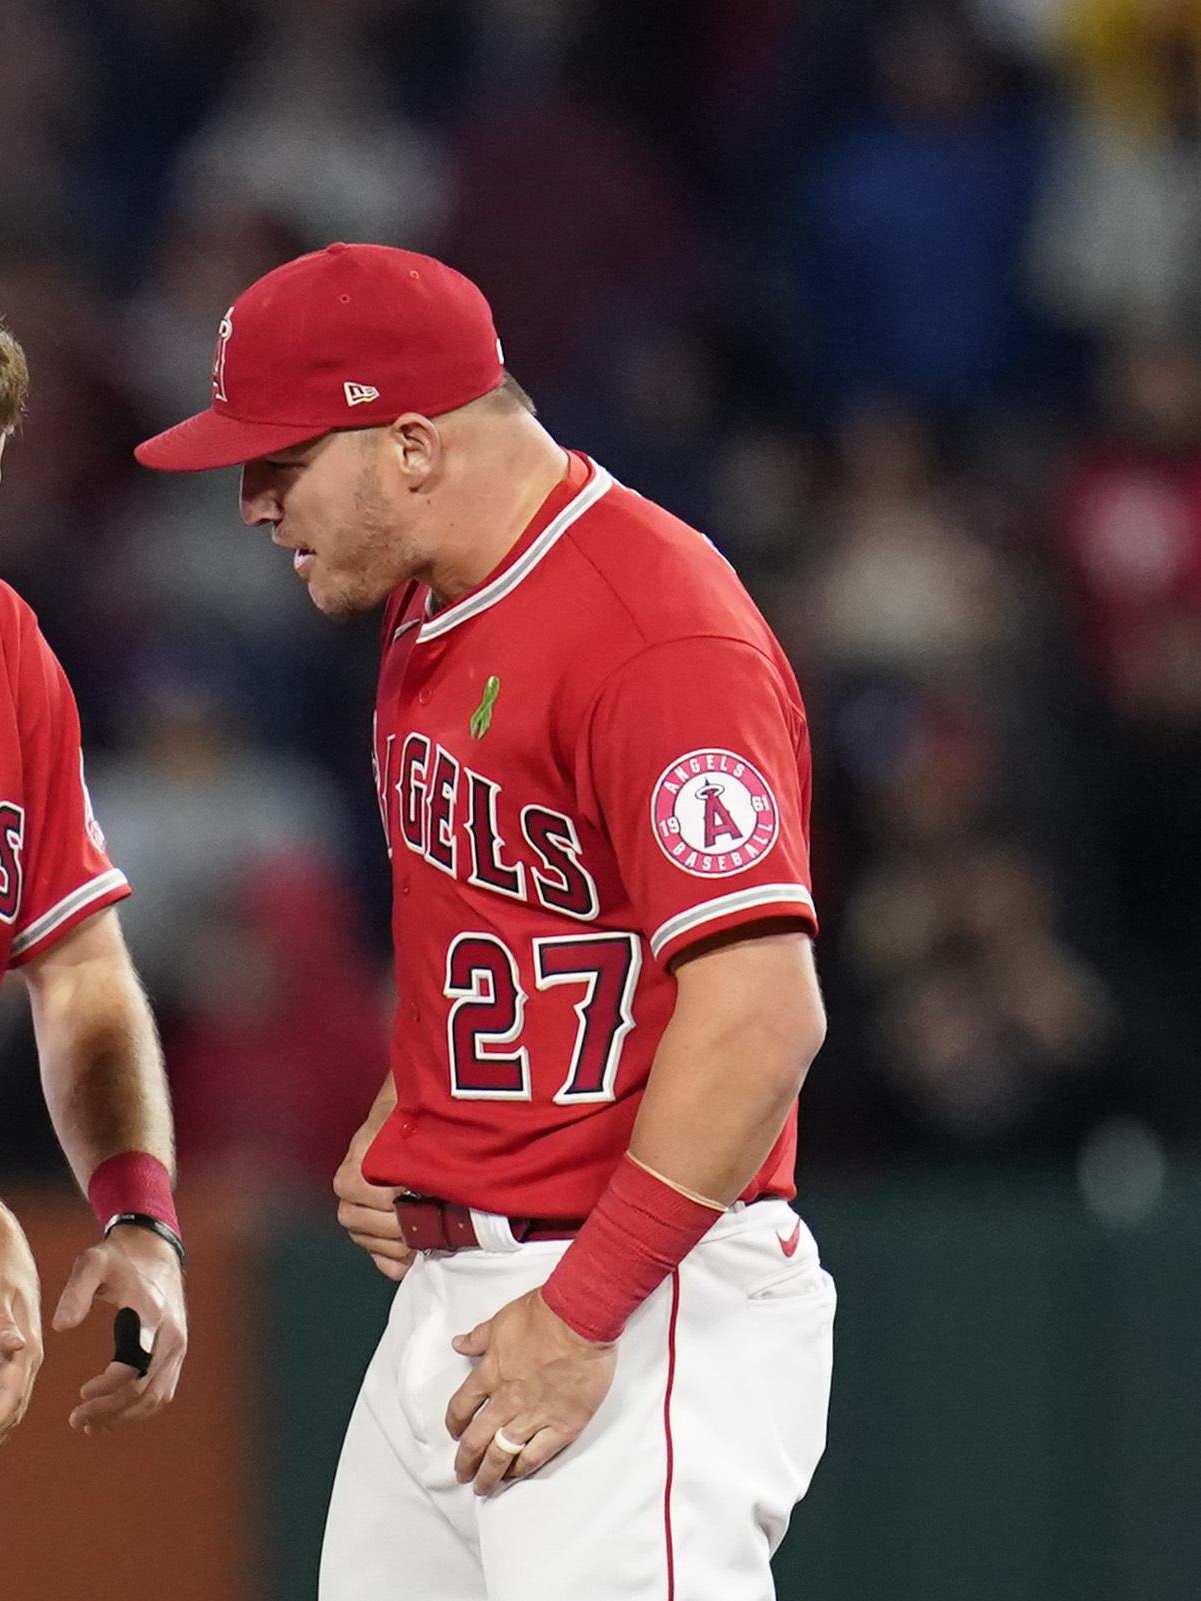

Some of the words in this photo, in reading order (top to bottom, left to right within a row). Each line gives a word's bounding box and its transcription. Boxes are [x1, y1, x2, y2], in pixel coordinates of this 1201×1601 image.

[664, 755, 745, 794] ANGELS
[659, 816, 680, 837] 19
[695, 778, 743, 848] A
[672, 823, 773, 871] BASEBALL
[443, 931, 641, 1105] 27
